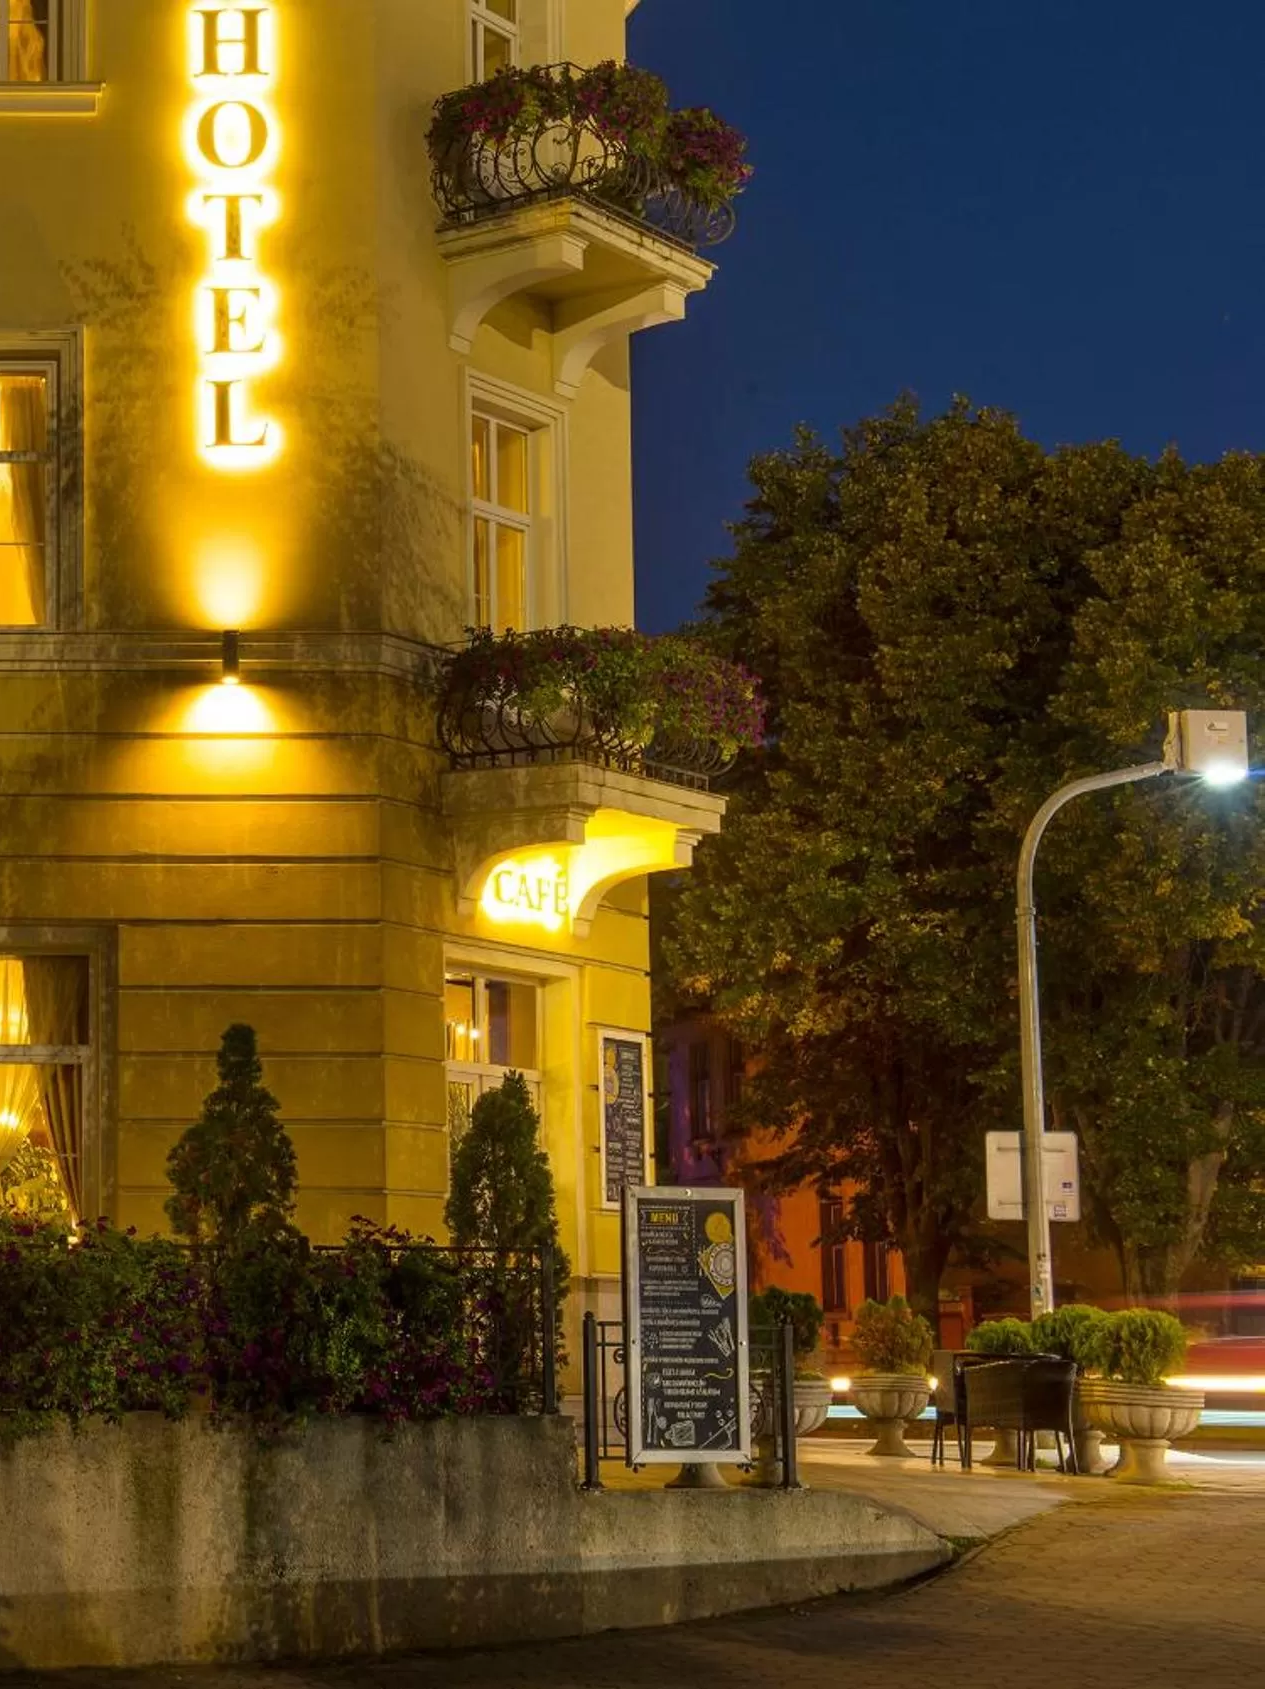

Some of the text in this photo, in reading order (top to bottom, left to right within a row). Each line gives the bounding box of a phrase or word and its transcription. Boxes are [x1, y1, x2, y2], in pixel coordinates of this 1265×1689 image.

[193, 8, 270, 448] HOTEL
[493, 868, 568, 916] CAFÉ
[650, 1212, 679, 1225] MENU
